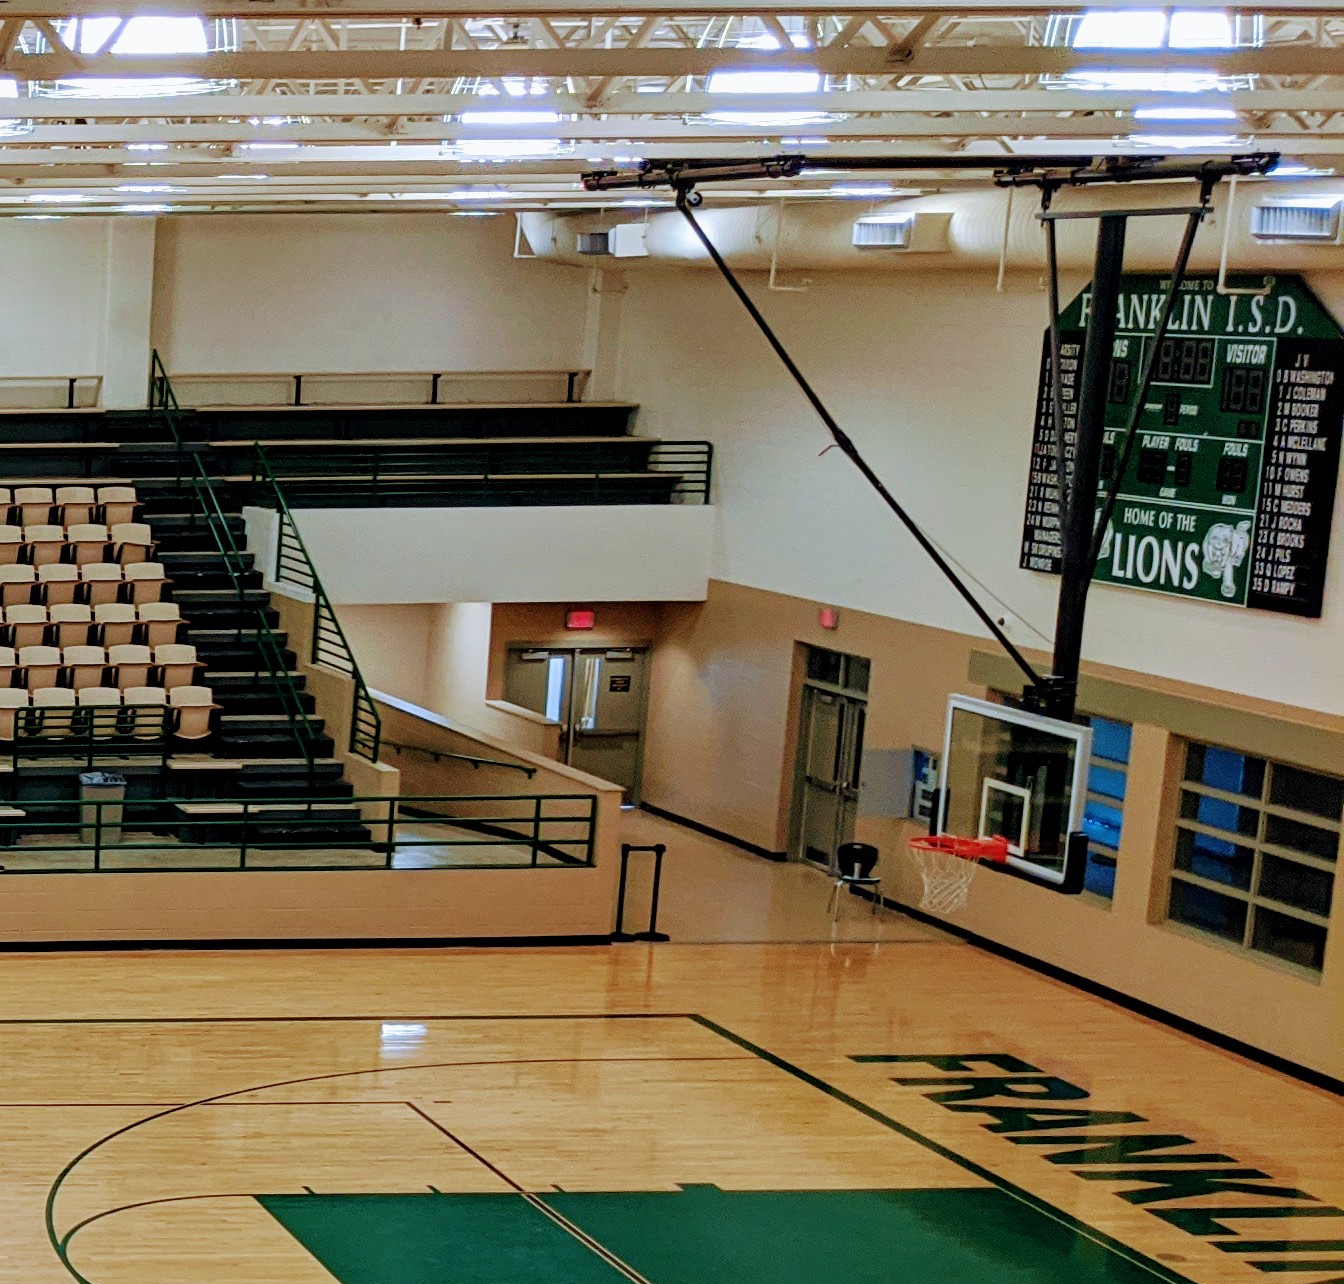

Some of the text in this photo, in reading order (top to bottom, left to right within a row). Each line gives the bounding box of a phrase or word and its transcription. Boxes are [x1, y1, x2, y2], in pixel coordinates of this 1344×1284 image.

[1226, 344, 1268, 364] VISITOR
[1142, 434, 1200, 452] PLAYER FOULS
[1222, 442, 1249, 458] FOULS
[1123, 507, 1197, 532] HOME OF THE
[1111, 532, 1200, 590] LIONS
